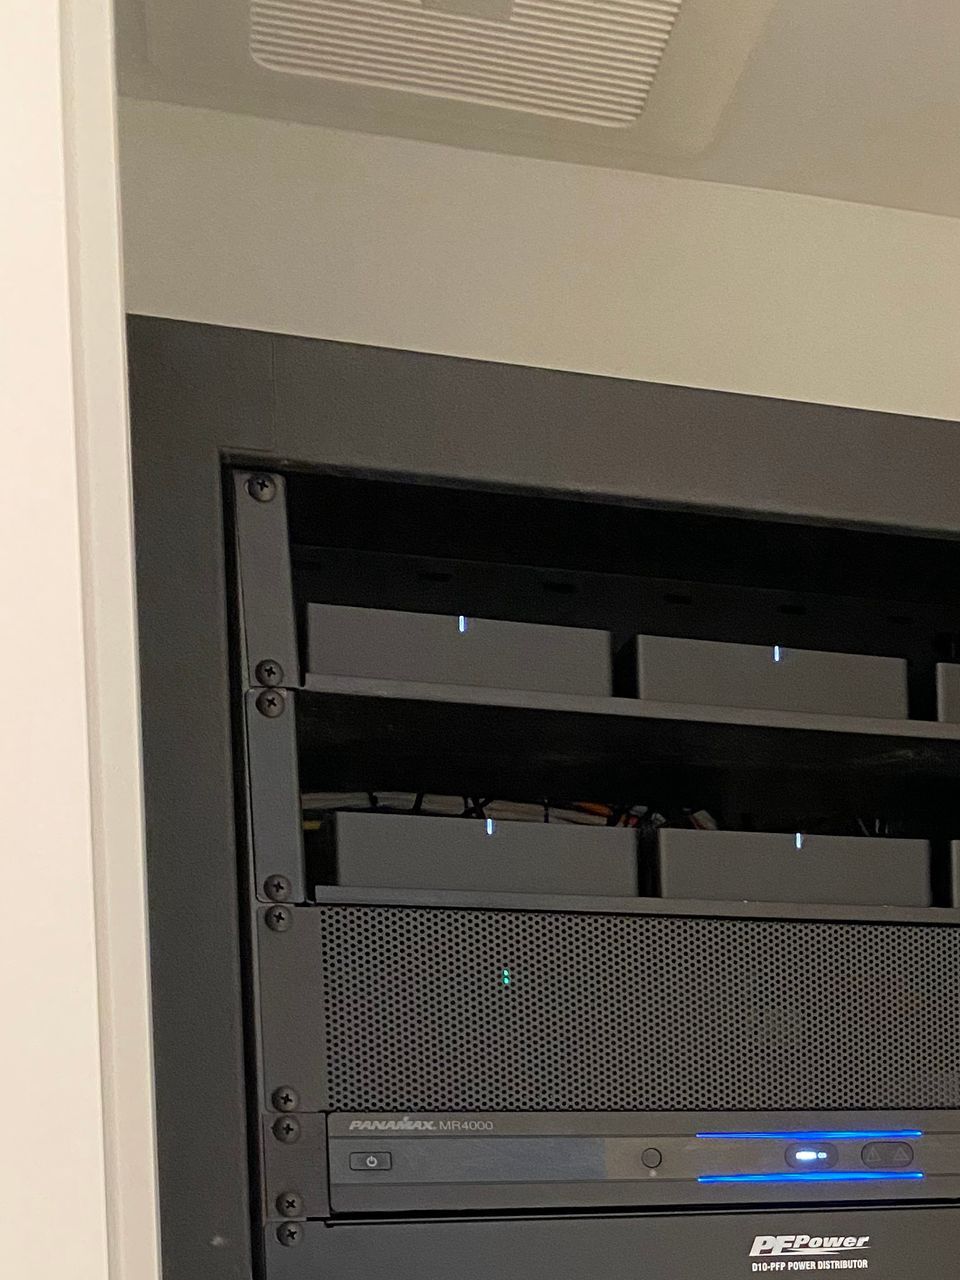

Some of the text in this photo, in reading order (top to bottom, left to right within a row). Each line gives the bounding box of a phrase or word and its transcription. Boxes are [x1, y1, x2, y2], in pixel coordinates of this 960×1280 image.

[348, 1116, 494, 1131] PANAMAX MR4000
[751, 1259, 868, 1272] D10-PFP POWER DISTRIBUTOR
